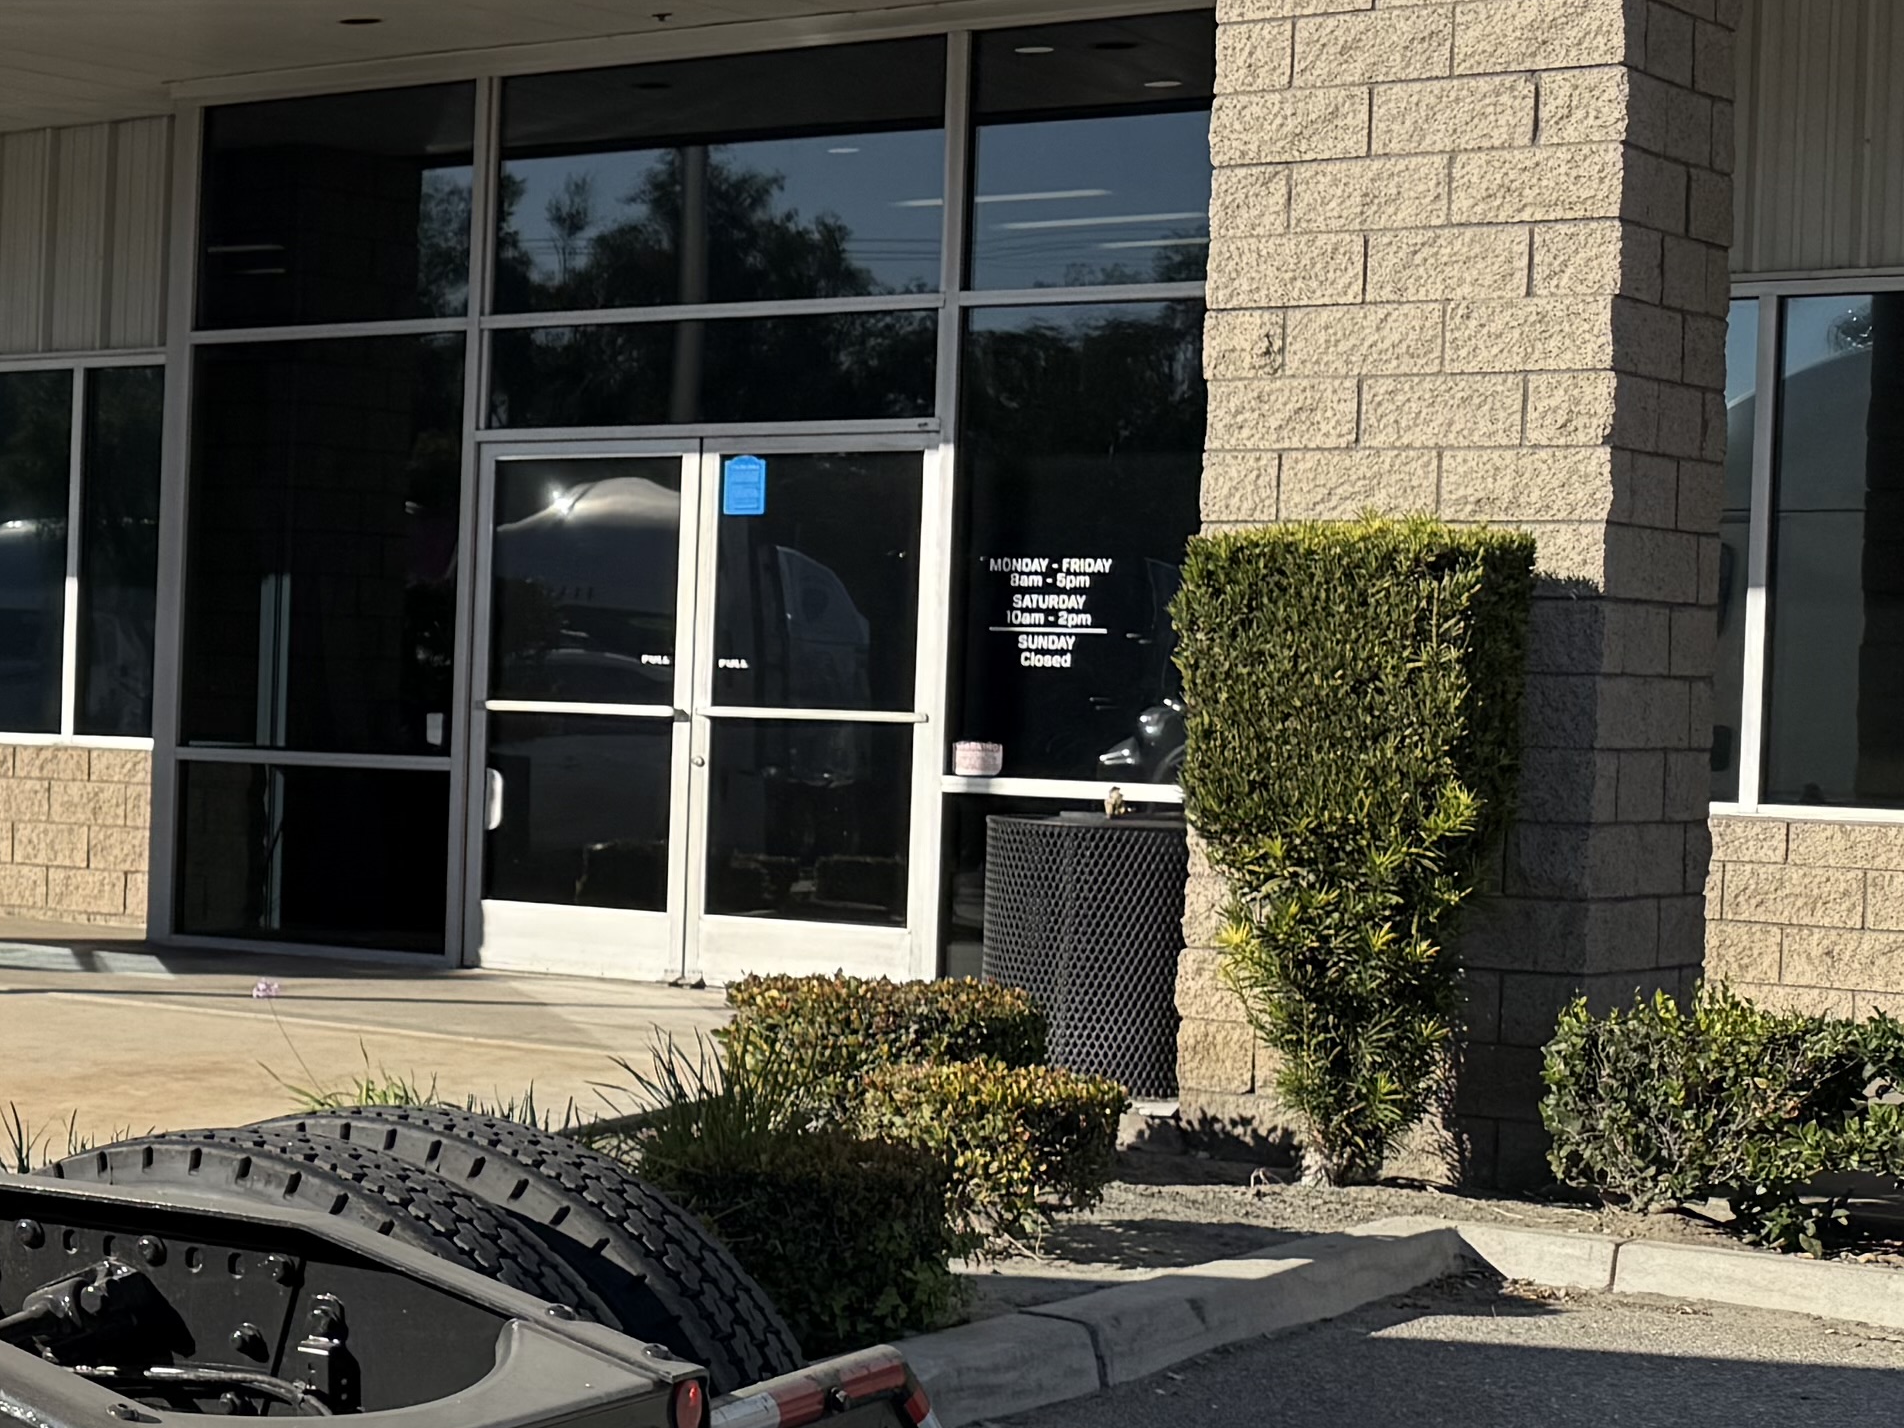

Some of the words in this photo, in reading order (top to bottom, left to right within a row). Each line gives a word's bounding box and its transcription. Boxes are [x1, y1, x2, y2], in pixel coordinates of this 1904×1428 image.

[989, 557, 1049, 573] MONDAY
[1062, 558, 1113, 573] FRIDAY
[1010, 573, 1043, 587] 8am
[1056, 573, 1091, 590] 5pm
[1012, 594, 1087, 609] SATURDAY
[1006, 610, 1045, 625] 10am
[1057, 611, 1092, 628] 2pm
[1017, 634, 1076, 650] SUNDAY
[1020, 651, 1072, 667] Closed
